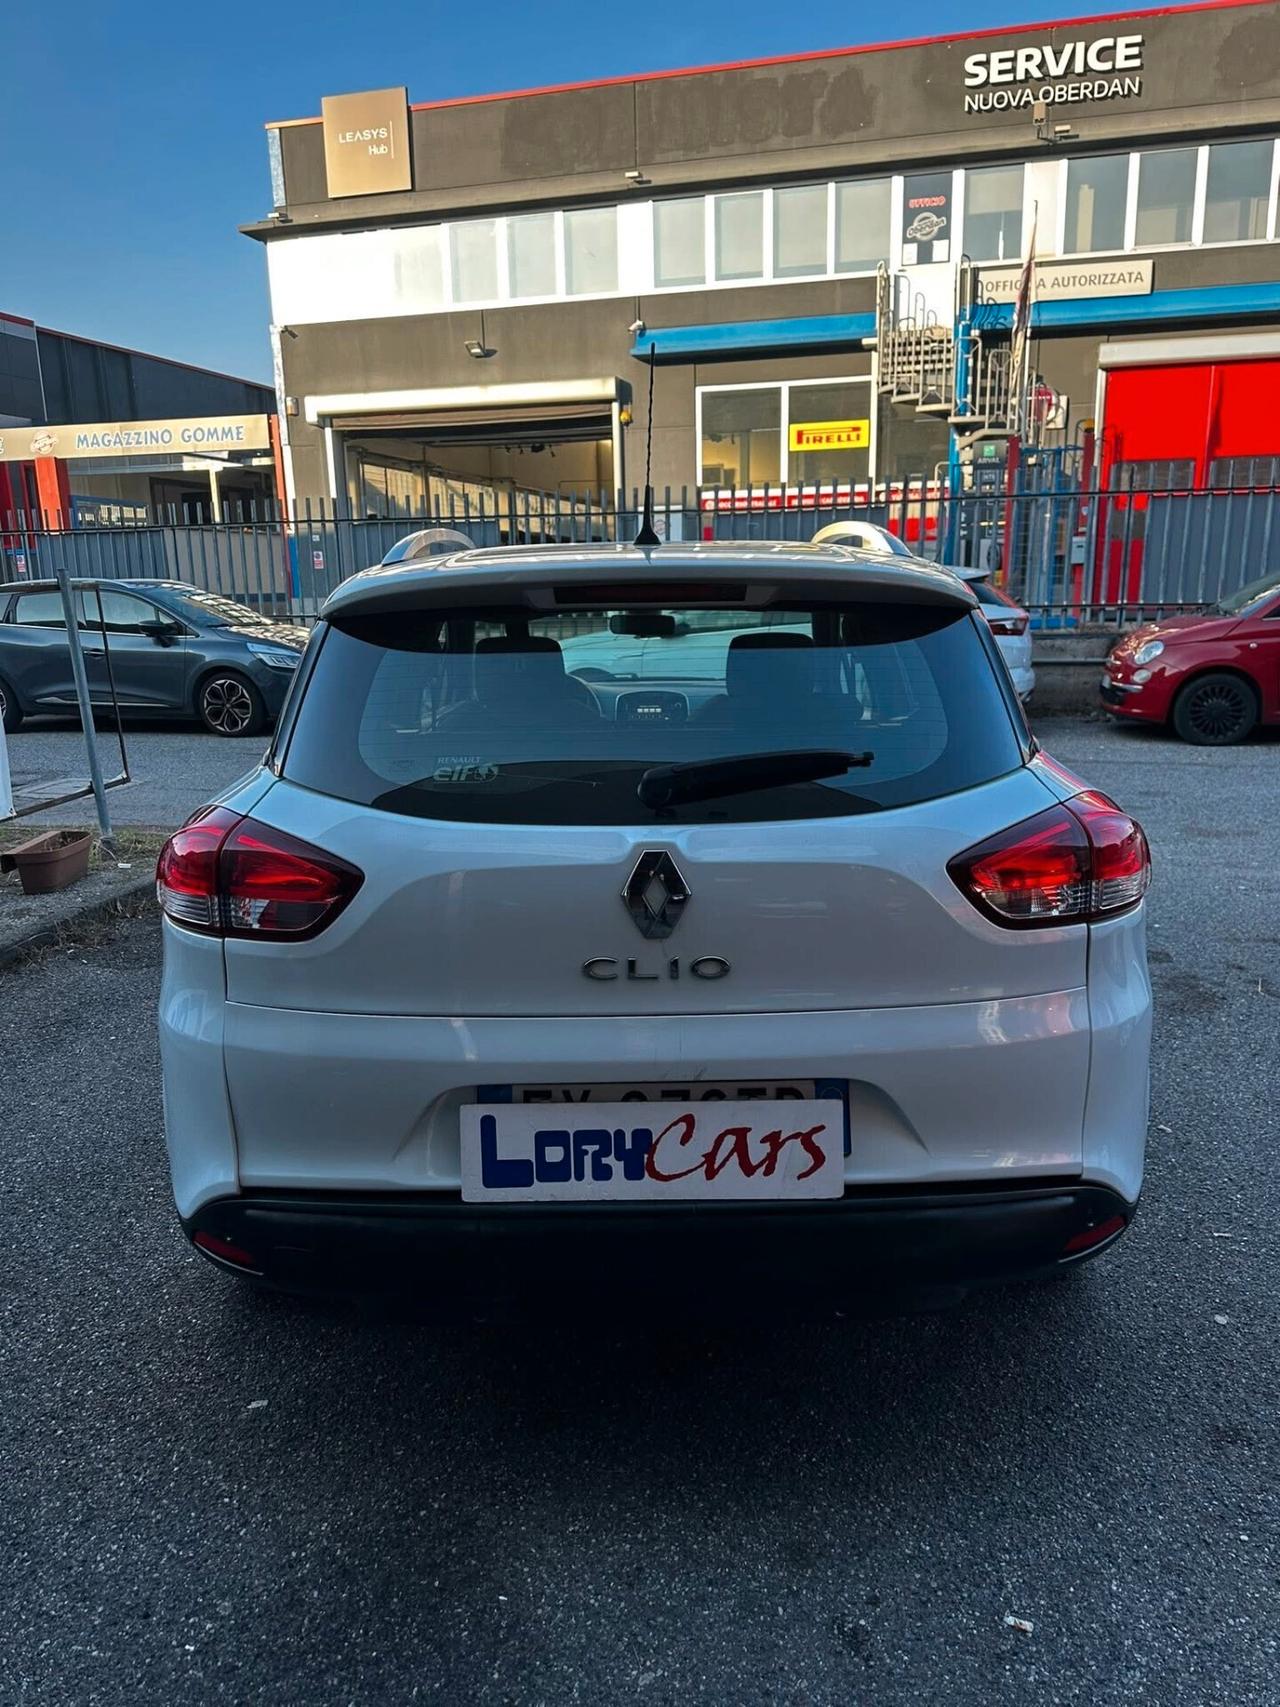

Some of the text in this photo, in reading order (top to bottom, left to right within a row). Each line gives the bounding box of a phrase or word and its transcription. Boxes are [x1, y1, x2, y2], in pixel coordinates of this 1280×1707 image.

[964, 34, 1143, 87] SERVICE
[964, 77, 1140, 111] NUOVA OBERDAN
[338, 128, 388, 143] LEASYS
[368, 144, 389, 156] Hub
[985, 271, 1145, 293] OFFICA AUTORIZZATA
[76, 428, 173, 449] MAGAZZINO
[181, 425, 245, 444] GOMME
[796, 426, 861, 445] PIRELLI
[437, 755, 481, 765] RENAULT
[582, 955, 732, 981] CLIO
